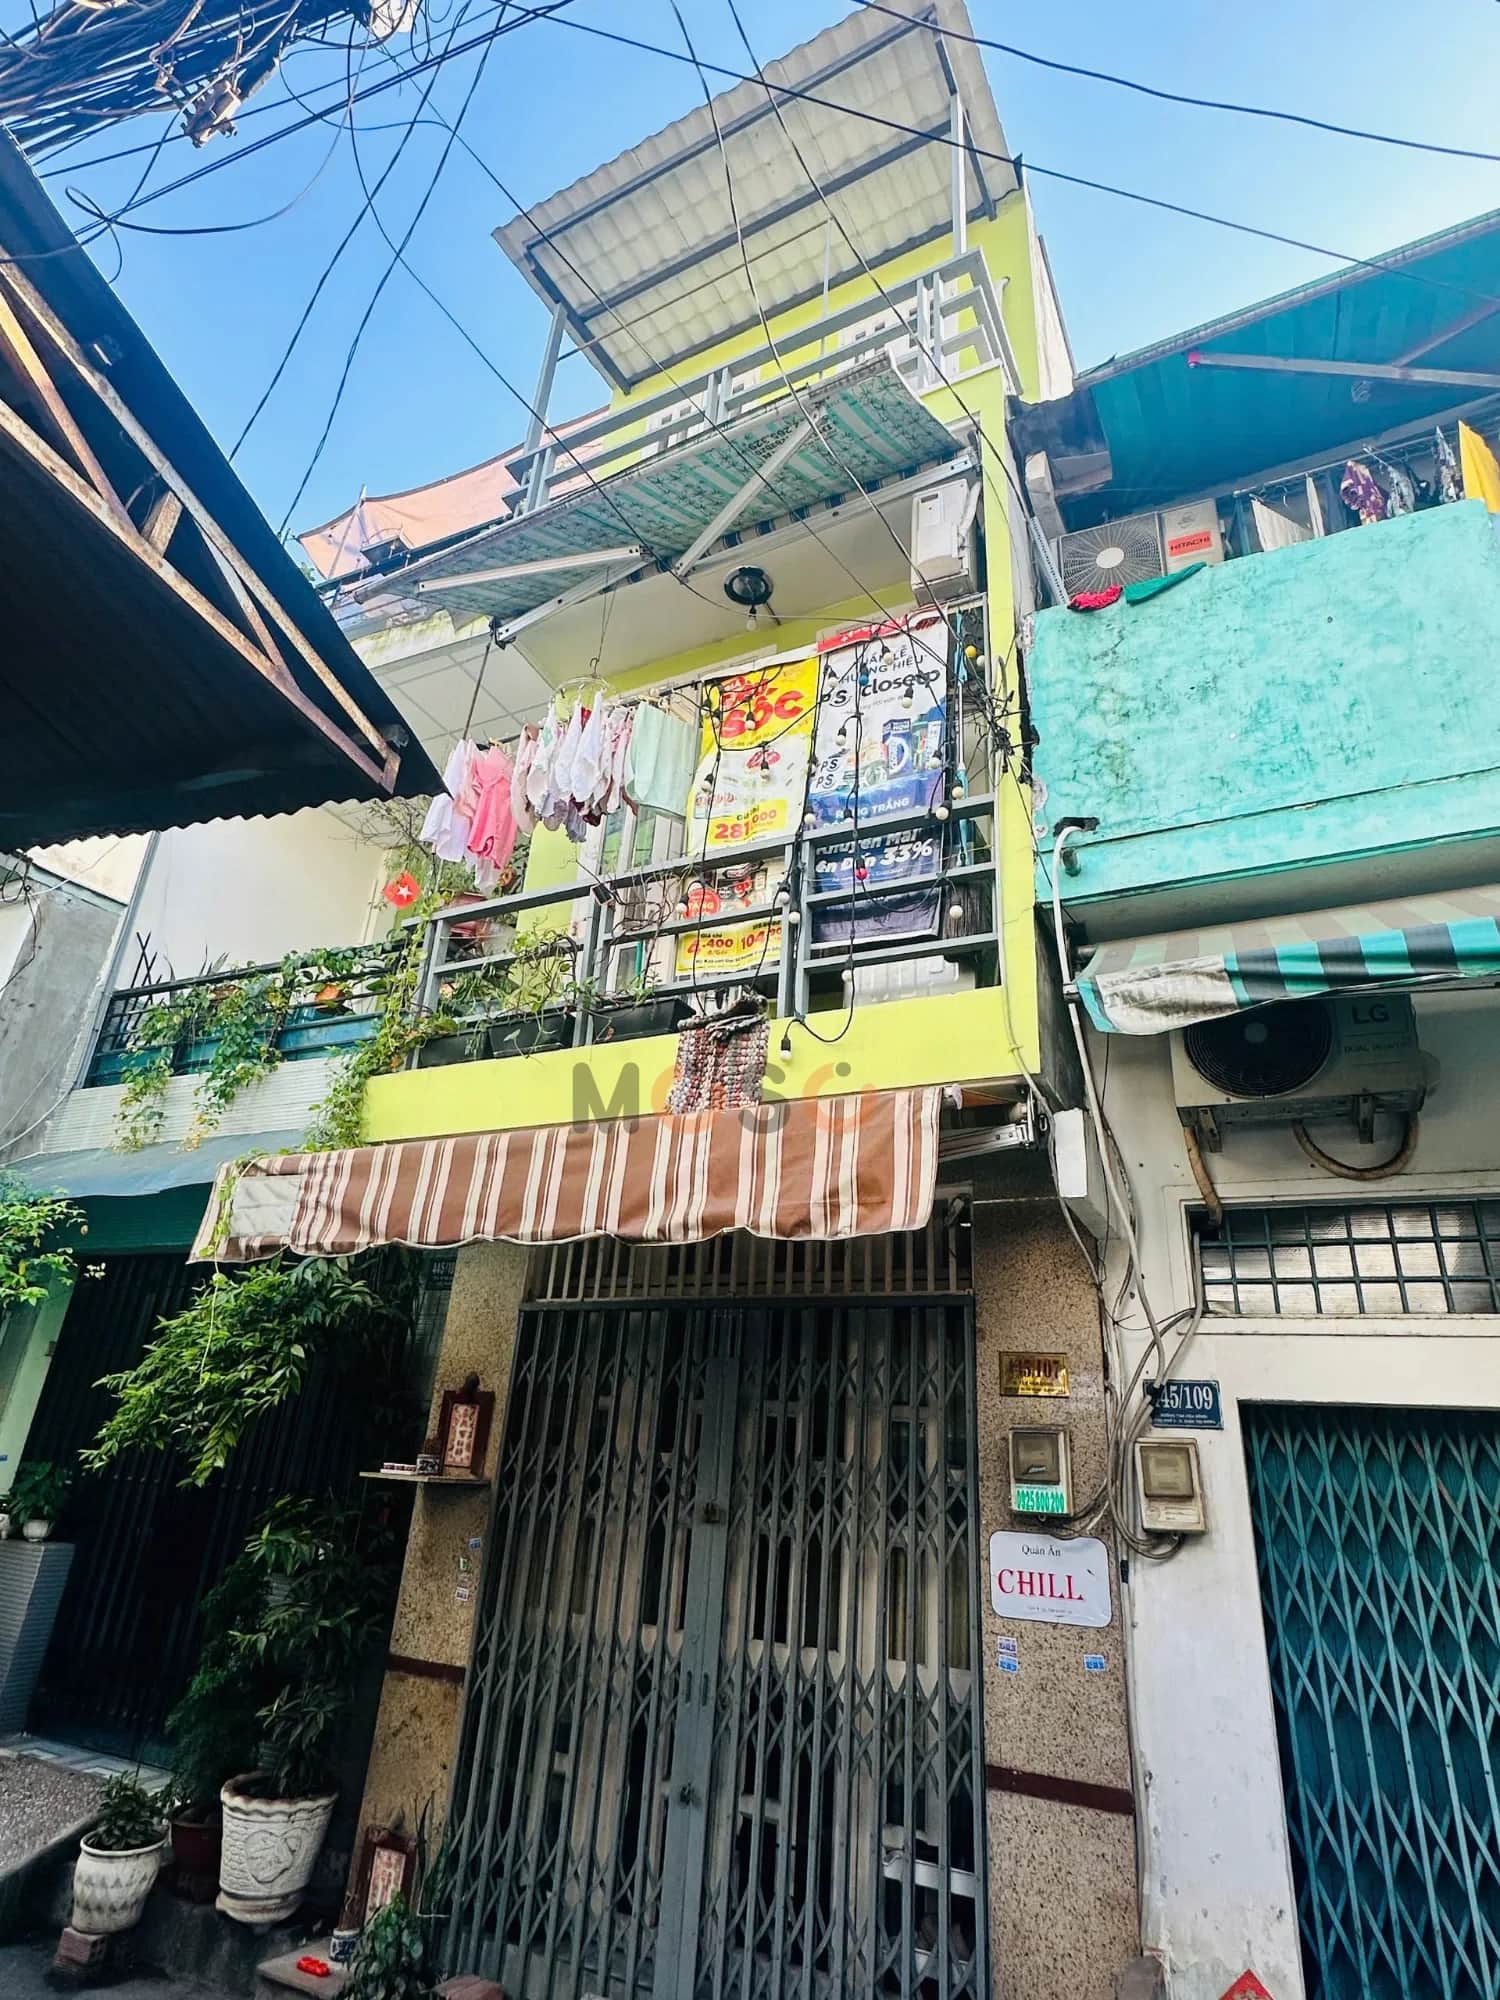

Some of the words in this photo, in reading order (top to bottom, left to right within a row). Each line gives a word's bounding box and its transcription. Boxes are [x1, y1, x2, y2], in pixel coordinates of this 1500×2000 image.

[1352, 1004, 1390, 1025] LG
[1155, 1384, 1213, 1410] 45/109
[997, 1568, 1084, 1601] CHILL
